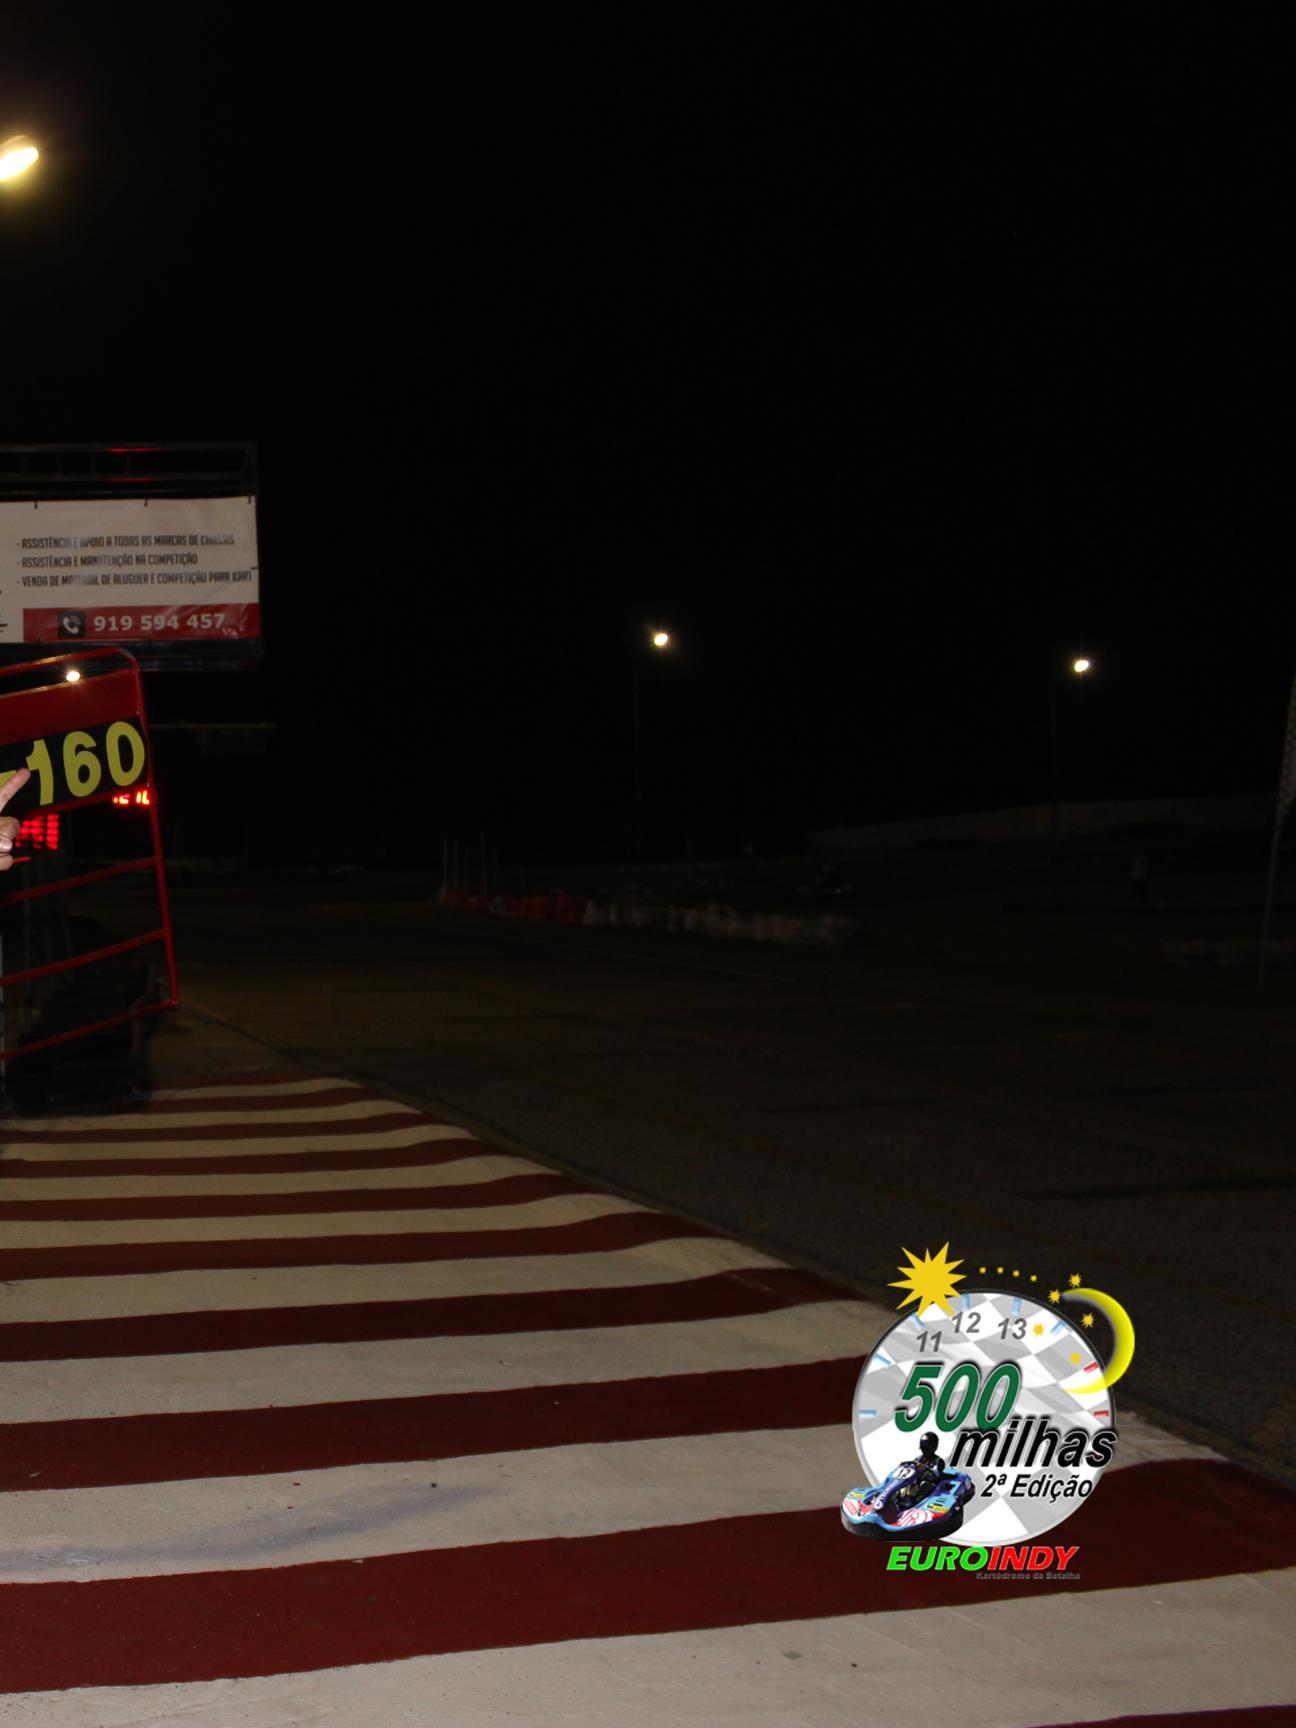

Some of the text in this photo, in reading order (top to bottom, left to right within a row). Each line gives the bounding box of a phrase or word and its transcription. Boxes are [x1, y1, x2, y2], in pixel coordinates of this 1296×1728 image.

[22, 536, 71, 549] ASSISTÊNCIA
[80, 536, 104, 548] APOIO
[106, 537, 112, 547] A
[114, 535, 139, 547] TODAS
[142, 535, 152, 546] AS
[154, 534, 187, 546] MARCAS
[189, 534, 199, 546] DE
[22, 552, 198, 568] ASSISTÊNCIA E MANUTENÇÃO NA COMPETIÇÃO
[23, 576, 47, 587] VENDA
[50, 575, 59, 586] DE
[102, 574, 111, 585] DE
[113, 572, 148, 585] ALUGUER
[150, 573, 156, 584] E
[157, 570, 207, 586] COMPETIÇÃO
[209, 571, 231, 583] PARA
[233, 570, 252, 582] KART
[94, 613, 225, 632] 919 594 457
